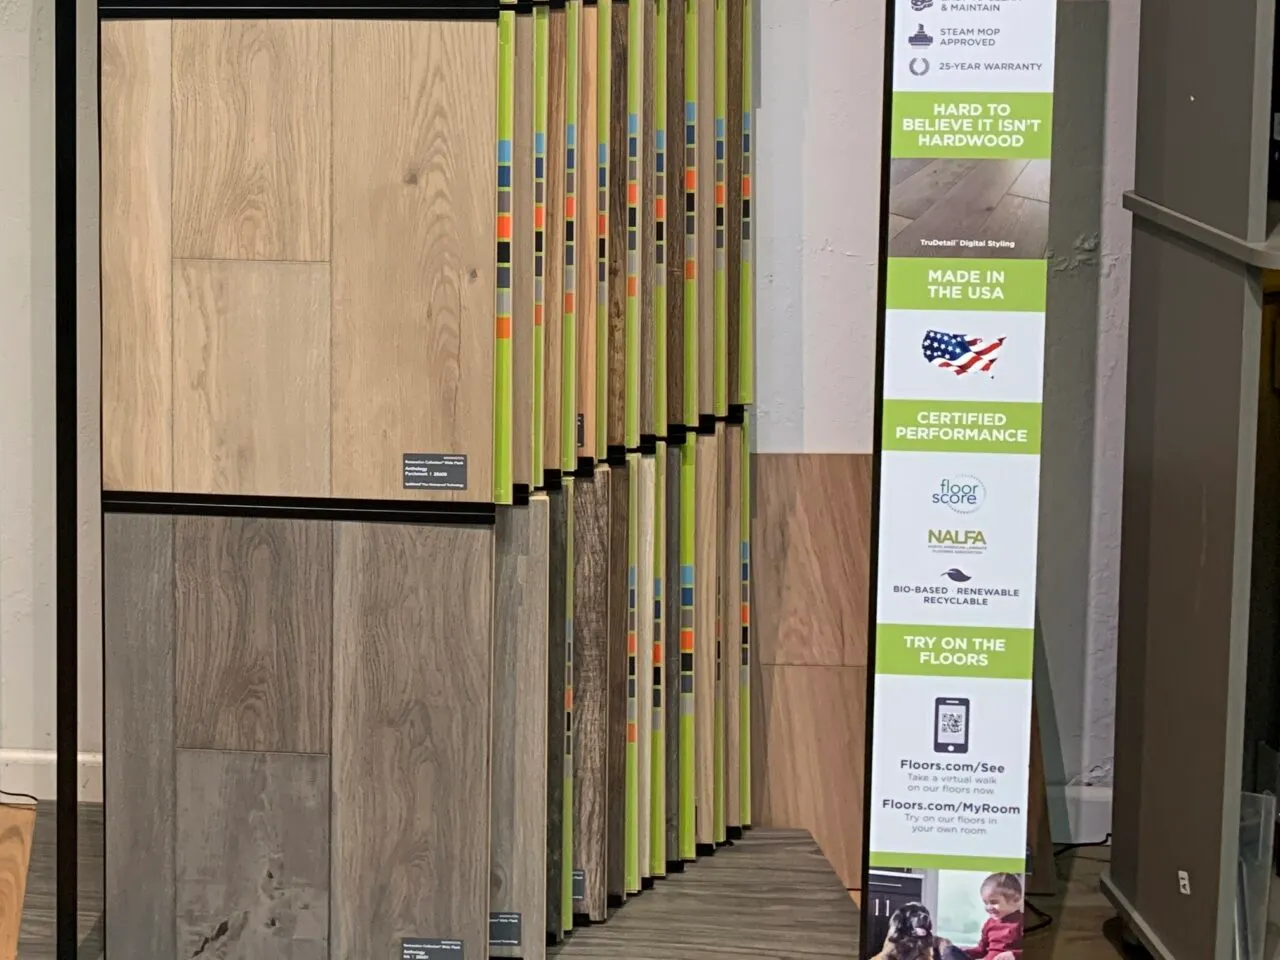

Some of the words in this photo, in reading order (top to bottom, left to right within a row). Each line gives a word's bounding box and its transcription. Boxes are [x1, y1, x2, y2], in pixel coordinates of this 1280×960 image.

[941, 3, 948, 12] &
[950, 3, 1001, 12] MAINTAIN
[940, 28, 974, 36] STEAM
[977, 28, 1001, 36] MOP
[940, 38, 996, 47] APPROVED
[939, 62, 981, 71] 25-YEAR
[984, 62, 1043, 71] WARRANTY
[933, 103, 982, 117] HARD
[988, 103, 1011, 117] TO
[902, 118, 972, 131] BELIEVE
[978, 119, 996, 132] IT
[998, 118, 1042, 132] ISN'T
[918, 134, 1024, 147] HARDWOOD
[960, 240, 985, 248] Digital
[987, 240, 1015, 248] Styling
[928, 270, 980, 283] MADE
[987, 271, 1005, 283] IN
[928, 286, 962, 298] THE
[969, 286, 1004, 299] USA
[917, 411, 1006, 425] CERTIFIED
[895, 426, 1027, 442] PERFORMANCE
[940, 479, 979, 494] floor
[932, 493, 977, 505] score
[928, 529, 987, 544] NALFA
[893, 585, 948, 594] BIO-BASED
[956, 587, 1020, 597] RENEWABLE
[923, 596, 988, 605] RECYCLABLE
[903, 635, 936, 648] TRY
[941, 636, 967, 649] ON
[972, 638, 1006, 651] THE
[920, 651, 989, 666] FLOORS
[900, 759, 1005, 774] Floors.com/See
[907, 773, 929, 781] Take
[941, 773, 971, 784] virtual
[974, 775, 997, 785] walk
[942, 784, 971, 795] floors
[882, 799, 1021, 815] Floors.com/MyRoom
[905, 813, 920, 824] Try
[957, 815, 985, 825] floors
[988, 815, 997, 824] in
[911, 825, 934, 834] your
[960, 826, 987, 835] room
